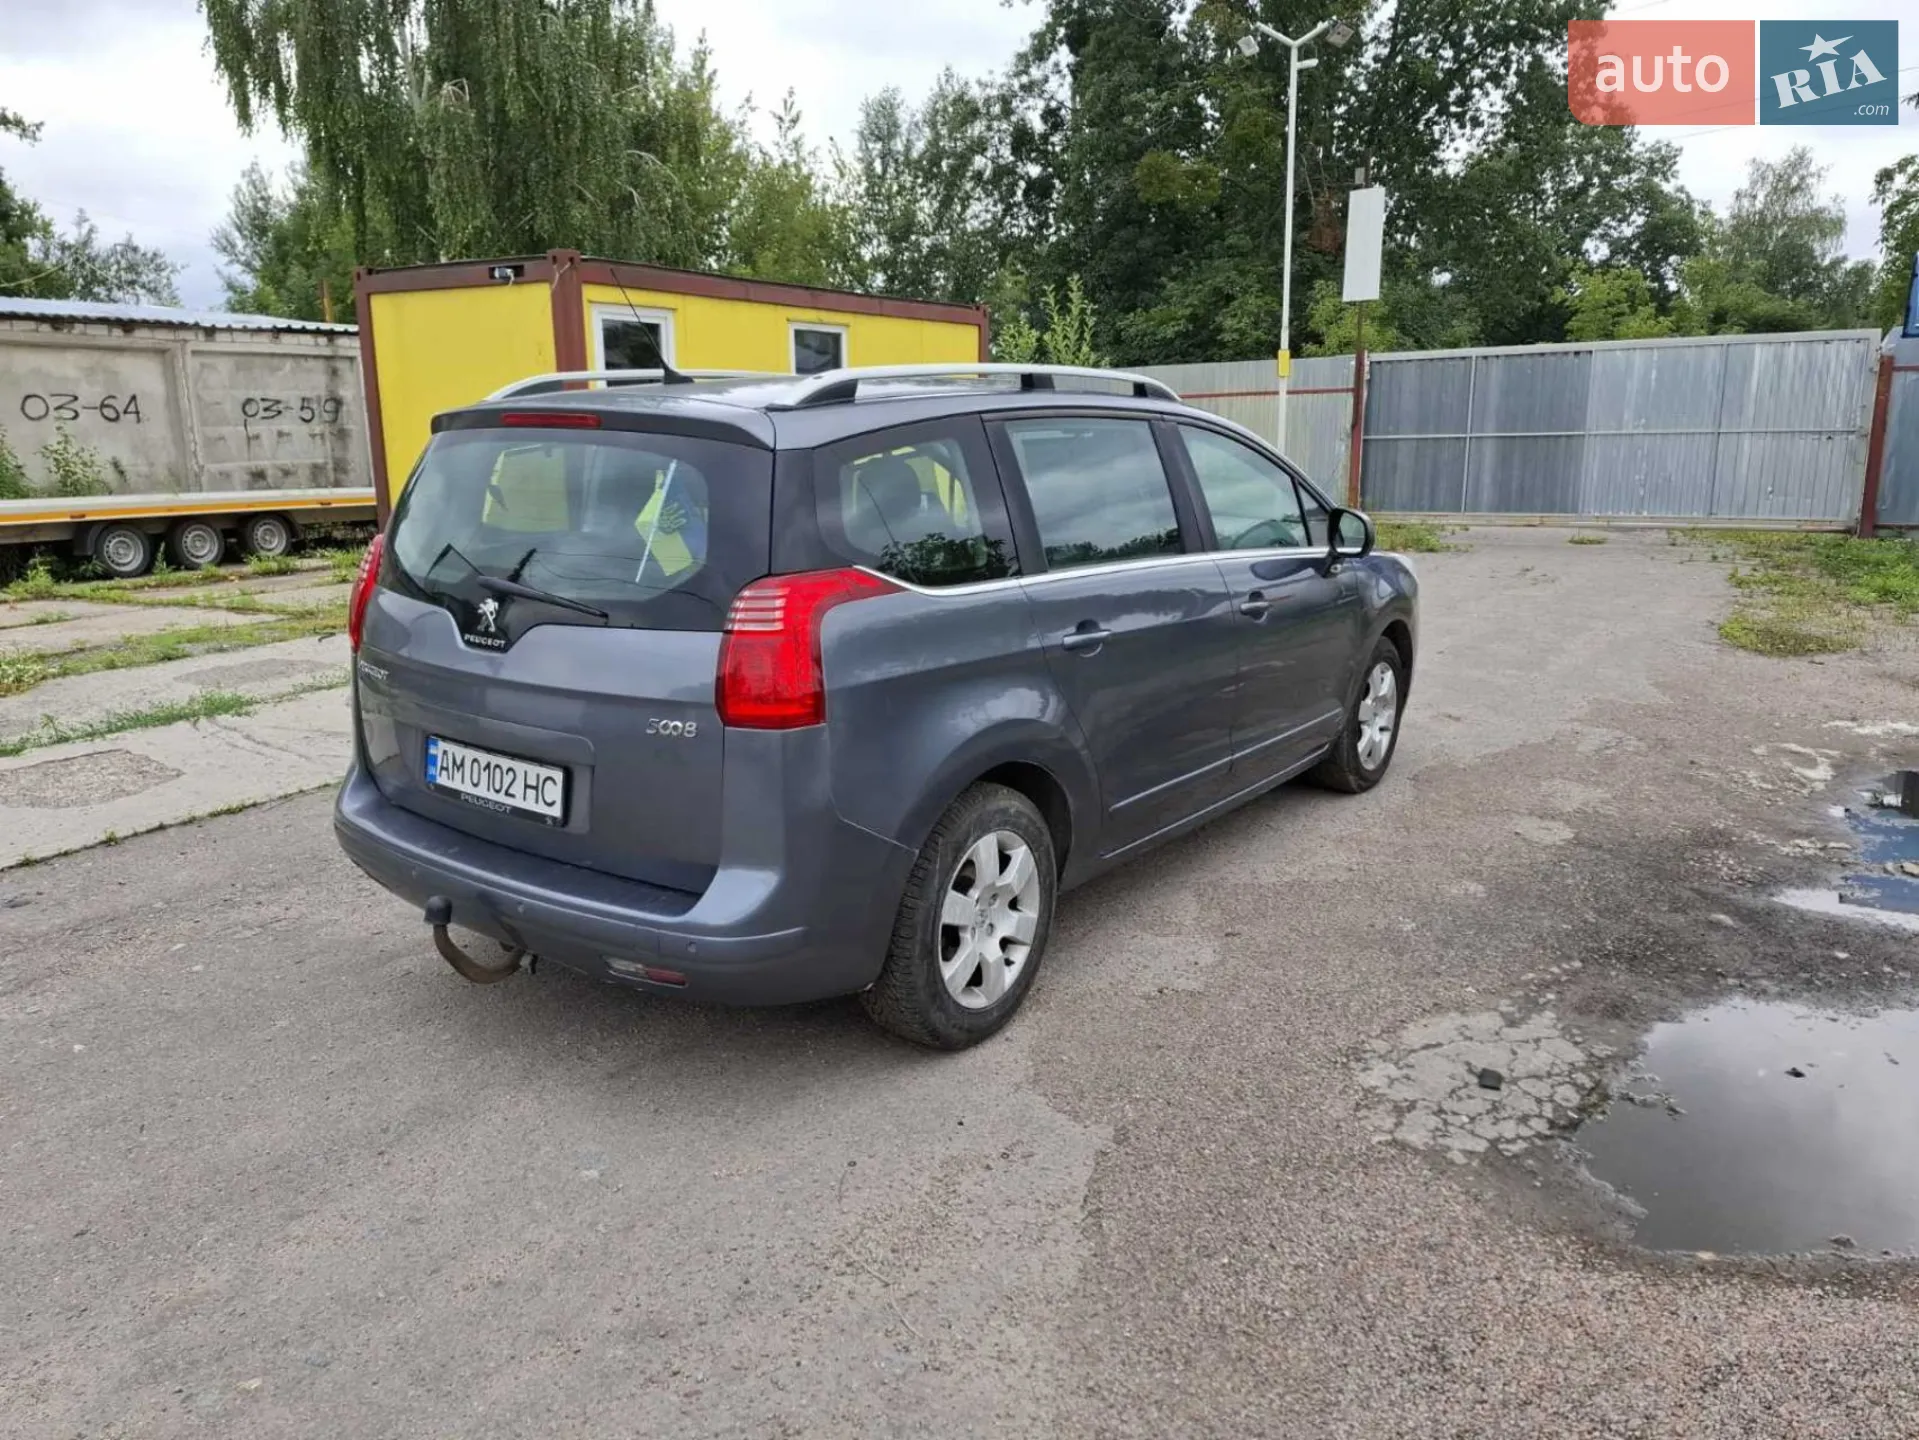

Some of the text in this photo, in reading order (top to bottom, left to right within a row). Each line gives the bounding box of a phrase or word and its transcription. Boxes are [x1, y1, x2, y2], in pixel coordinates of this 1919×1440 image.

[20, 393, 142, 424] 03-64
[241, 397, 343, 424] 03-59
[464, 633, 506, 648] PEUGEOT
[645, 718, 697, 738] 5008
[439, 749, 558, 807] AM 0102 HC
[461, 793, 513, 814] PEUGEOT
